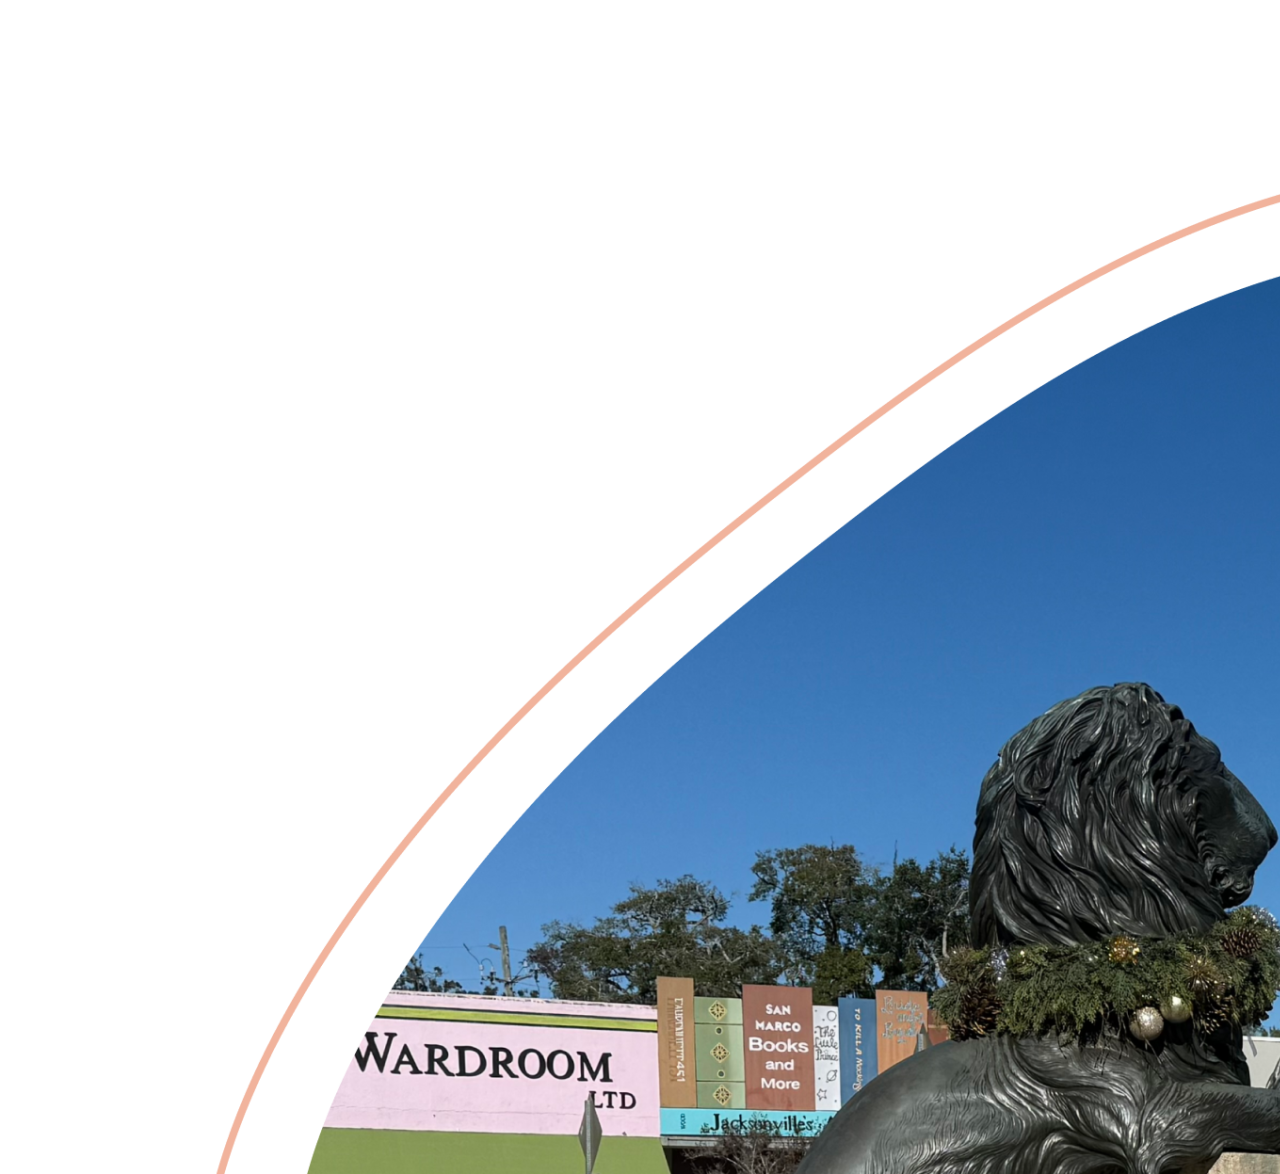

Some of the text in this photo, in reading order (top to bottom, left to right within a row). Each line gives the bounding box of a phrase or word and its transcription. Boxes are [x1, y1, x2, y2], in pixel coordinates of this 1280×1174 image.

[765, 1003, 791, 1015] SAN
[854, 1008, 861, 1020] TO
[755, 1020, 802, 1033] MARCO
[814, 1025, 835, 1038] The
[748, 1036, 810, 1054] Books
[353, 1031, 613, 1083] WARDROOM
[815, 1048, 839, 1061] Prince
[765, 1058, 795, 1071] and
[676, 1061, 686, 1082] 451
[761, 1076, 801, 1090] More
[589, 1091, 637, 1109] LTD
[709, 1113, 813, 1133] Jacksonville's
